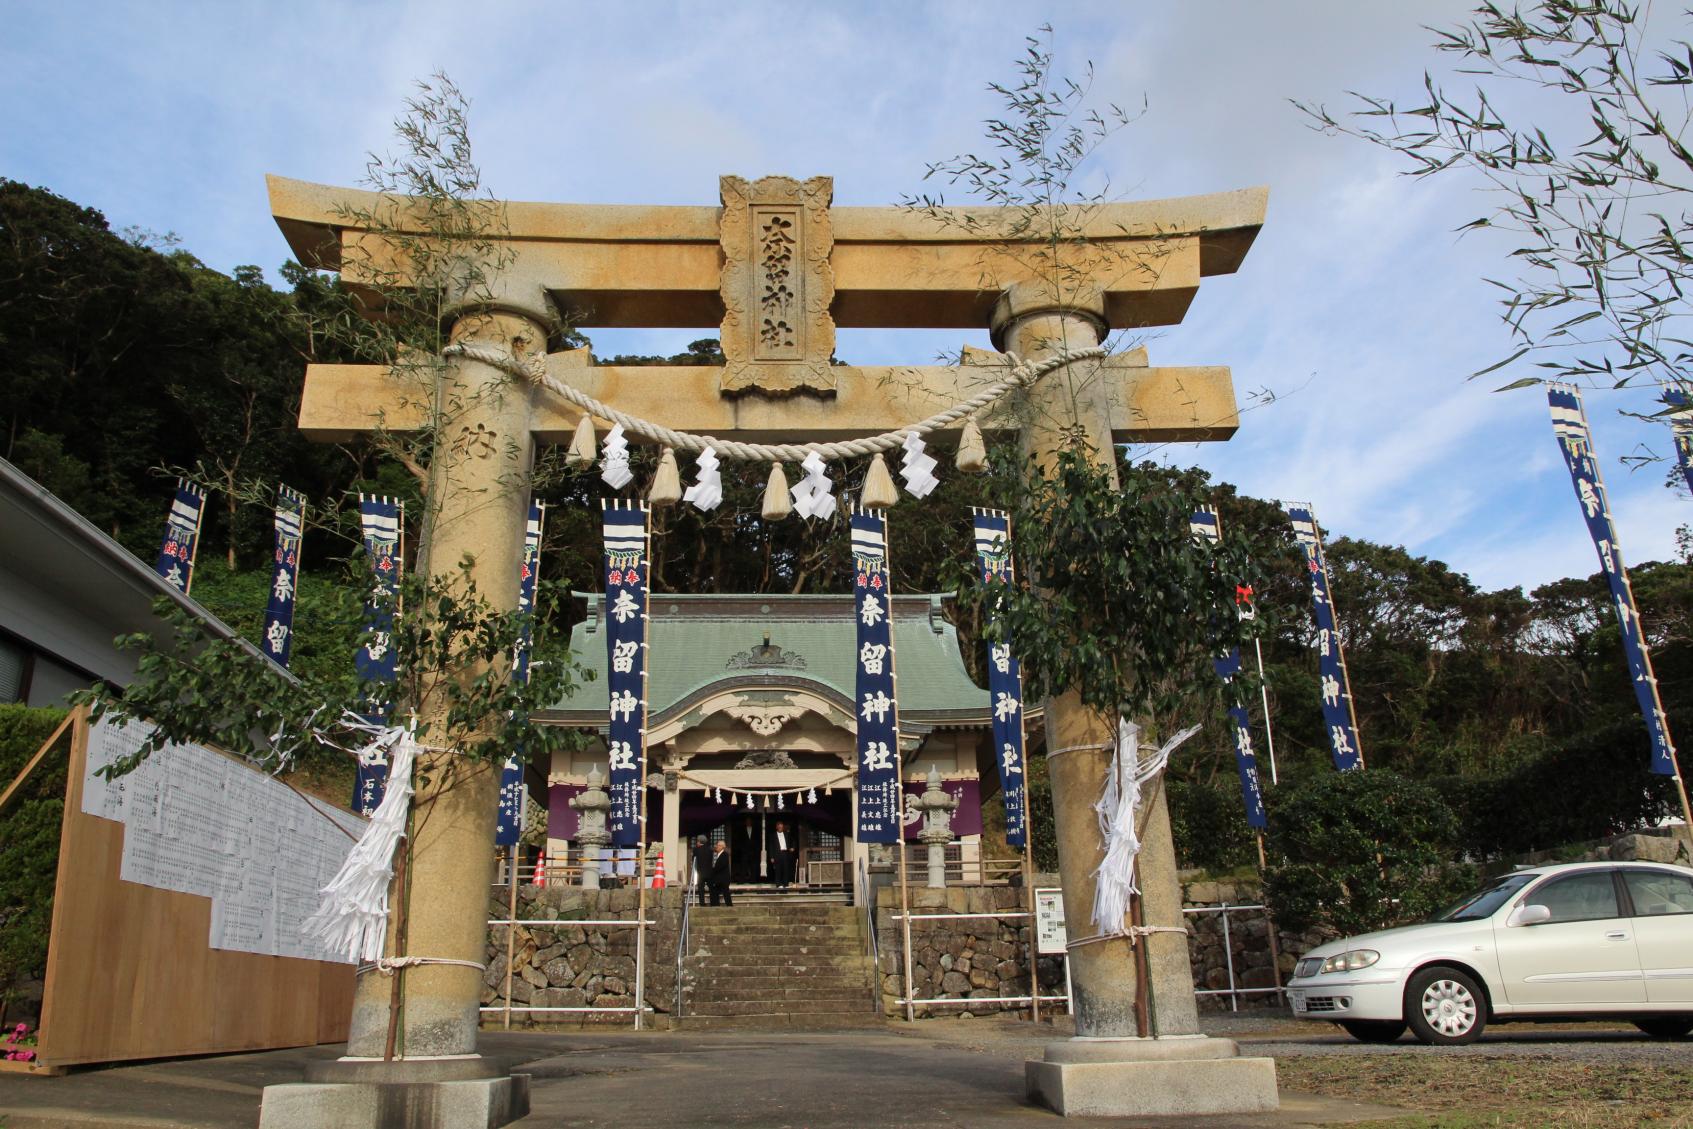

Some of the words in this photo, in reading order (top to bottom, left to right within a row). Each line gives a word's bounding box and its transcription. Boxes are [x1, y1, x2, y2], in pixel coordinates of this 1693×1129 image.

[608, 569, 641, 586] 奉納
[856, 572, 884, 590] 奉納
[608, 589, 641, 772] 奈留神社
[858, 593, 895, 772] 奈留神社
